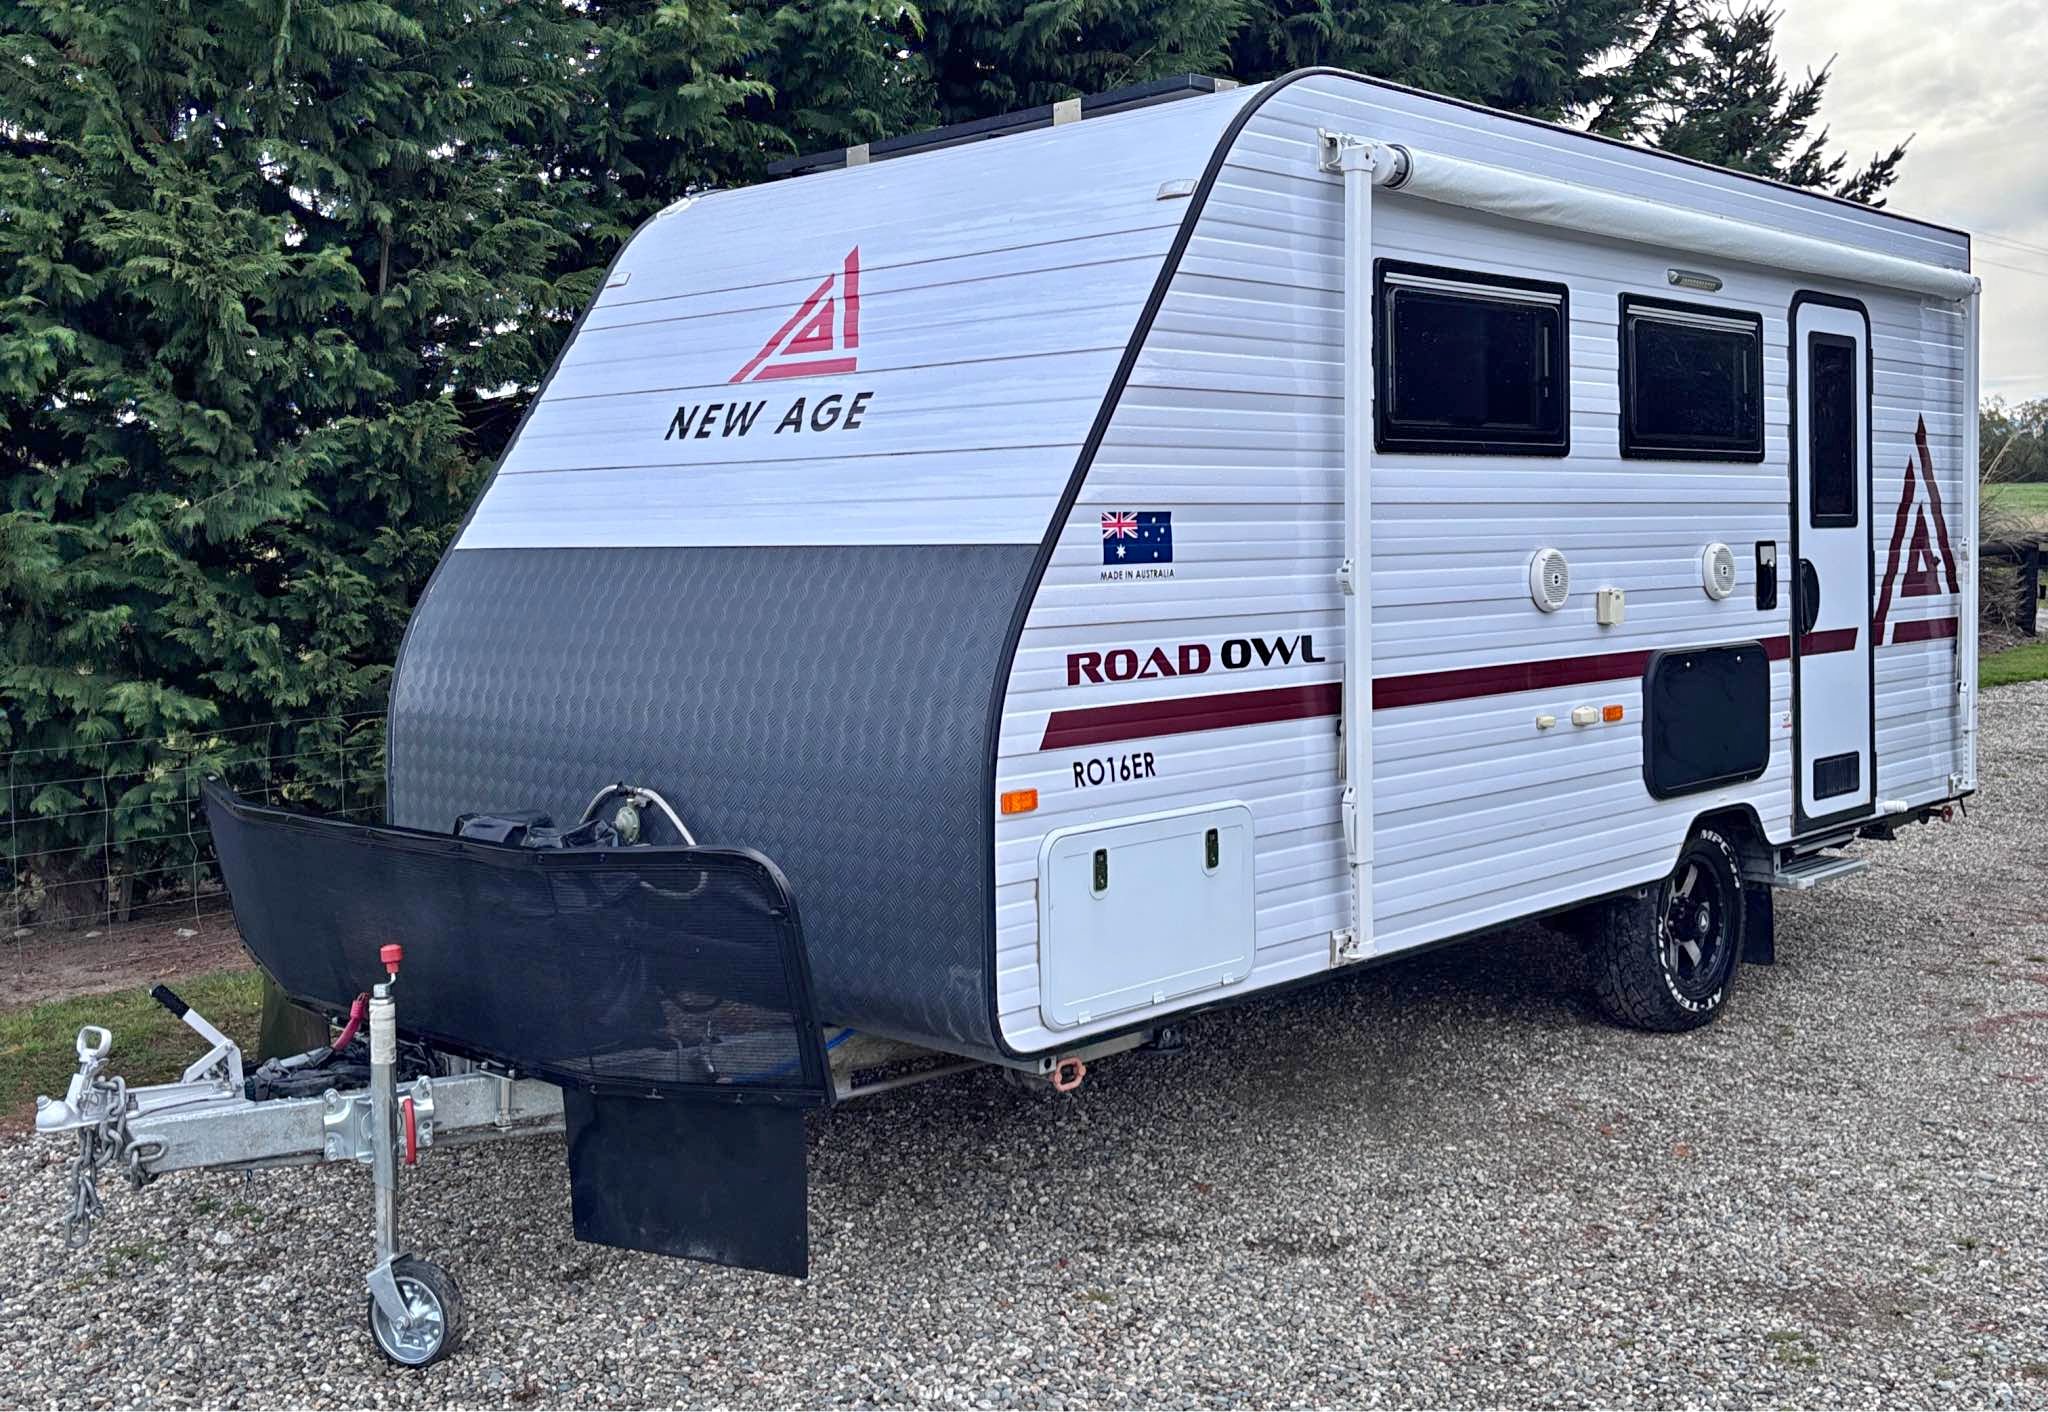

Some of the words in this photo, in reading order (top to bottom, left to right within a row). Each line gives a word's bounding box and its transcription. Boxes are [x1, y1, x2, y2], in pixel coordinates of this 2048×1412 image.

[664, 400, 768, 440] NEW
[774, 392, 874, 434] AGE
[1101, 570, 1122, 580] MADE
[1125, 570, 1133, 579] IN
[1136, 569, 1174, 579] AUSTRALIA
[1067, 643, 1211, 686] ROAD
[1221, 634, 1325, 669] OWL
[1073, 752, 1156, 788] RO16ER
